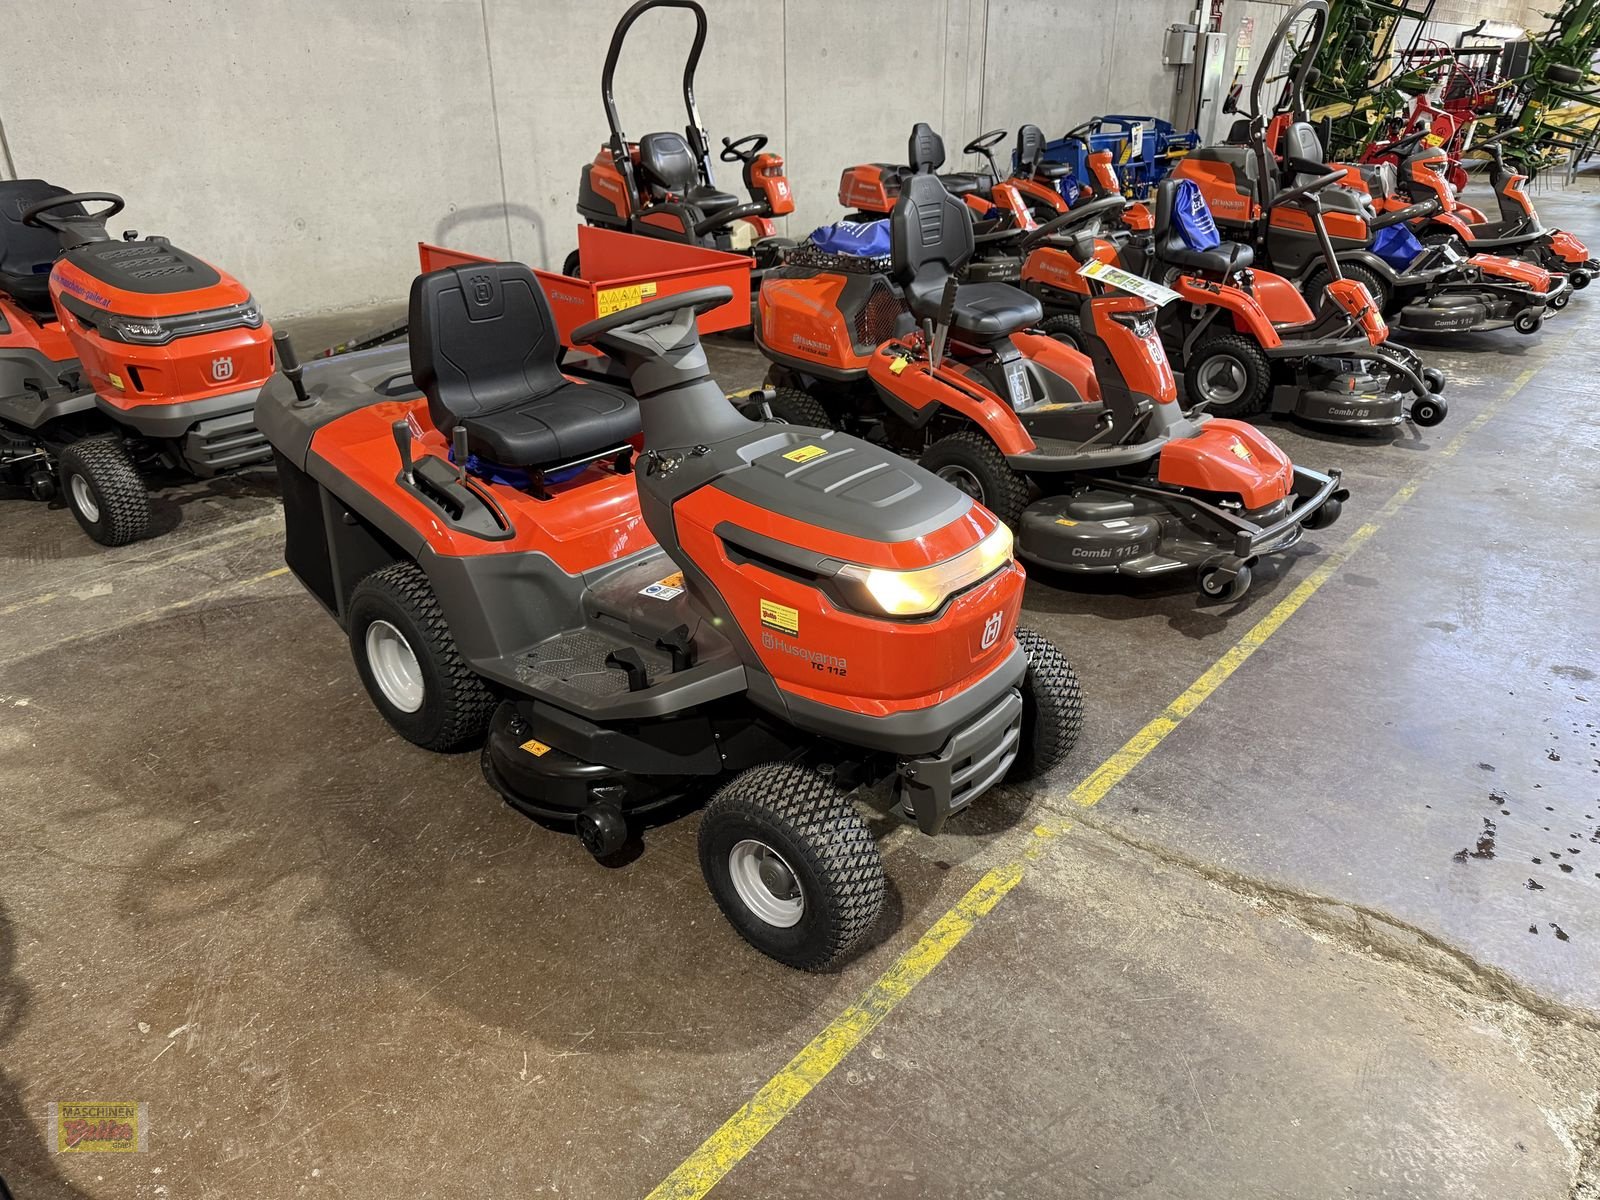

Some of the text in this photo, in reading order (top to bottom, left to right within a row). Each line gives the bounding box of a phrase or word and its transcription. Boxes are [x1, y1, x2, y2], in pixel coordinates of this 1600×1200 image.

[1071, 544, 1140, 558] Combi 112
[775, 637, 847, 669] Husqvarna
[811, 661, 847, 677] TC 112
